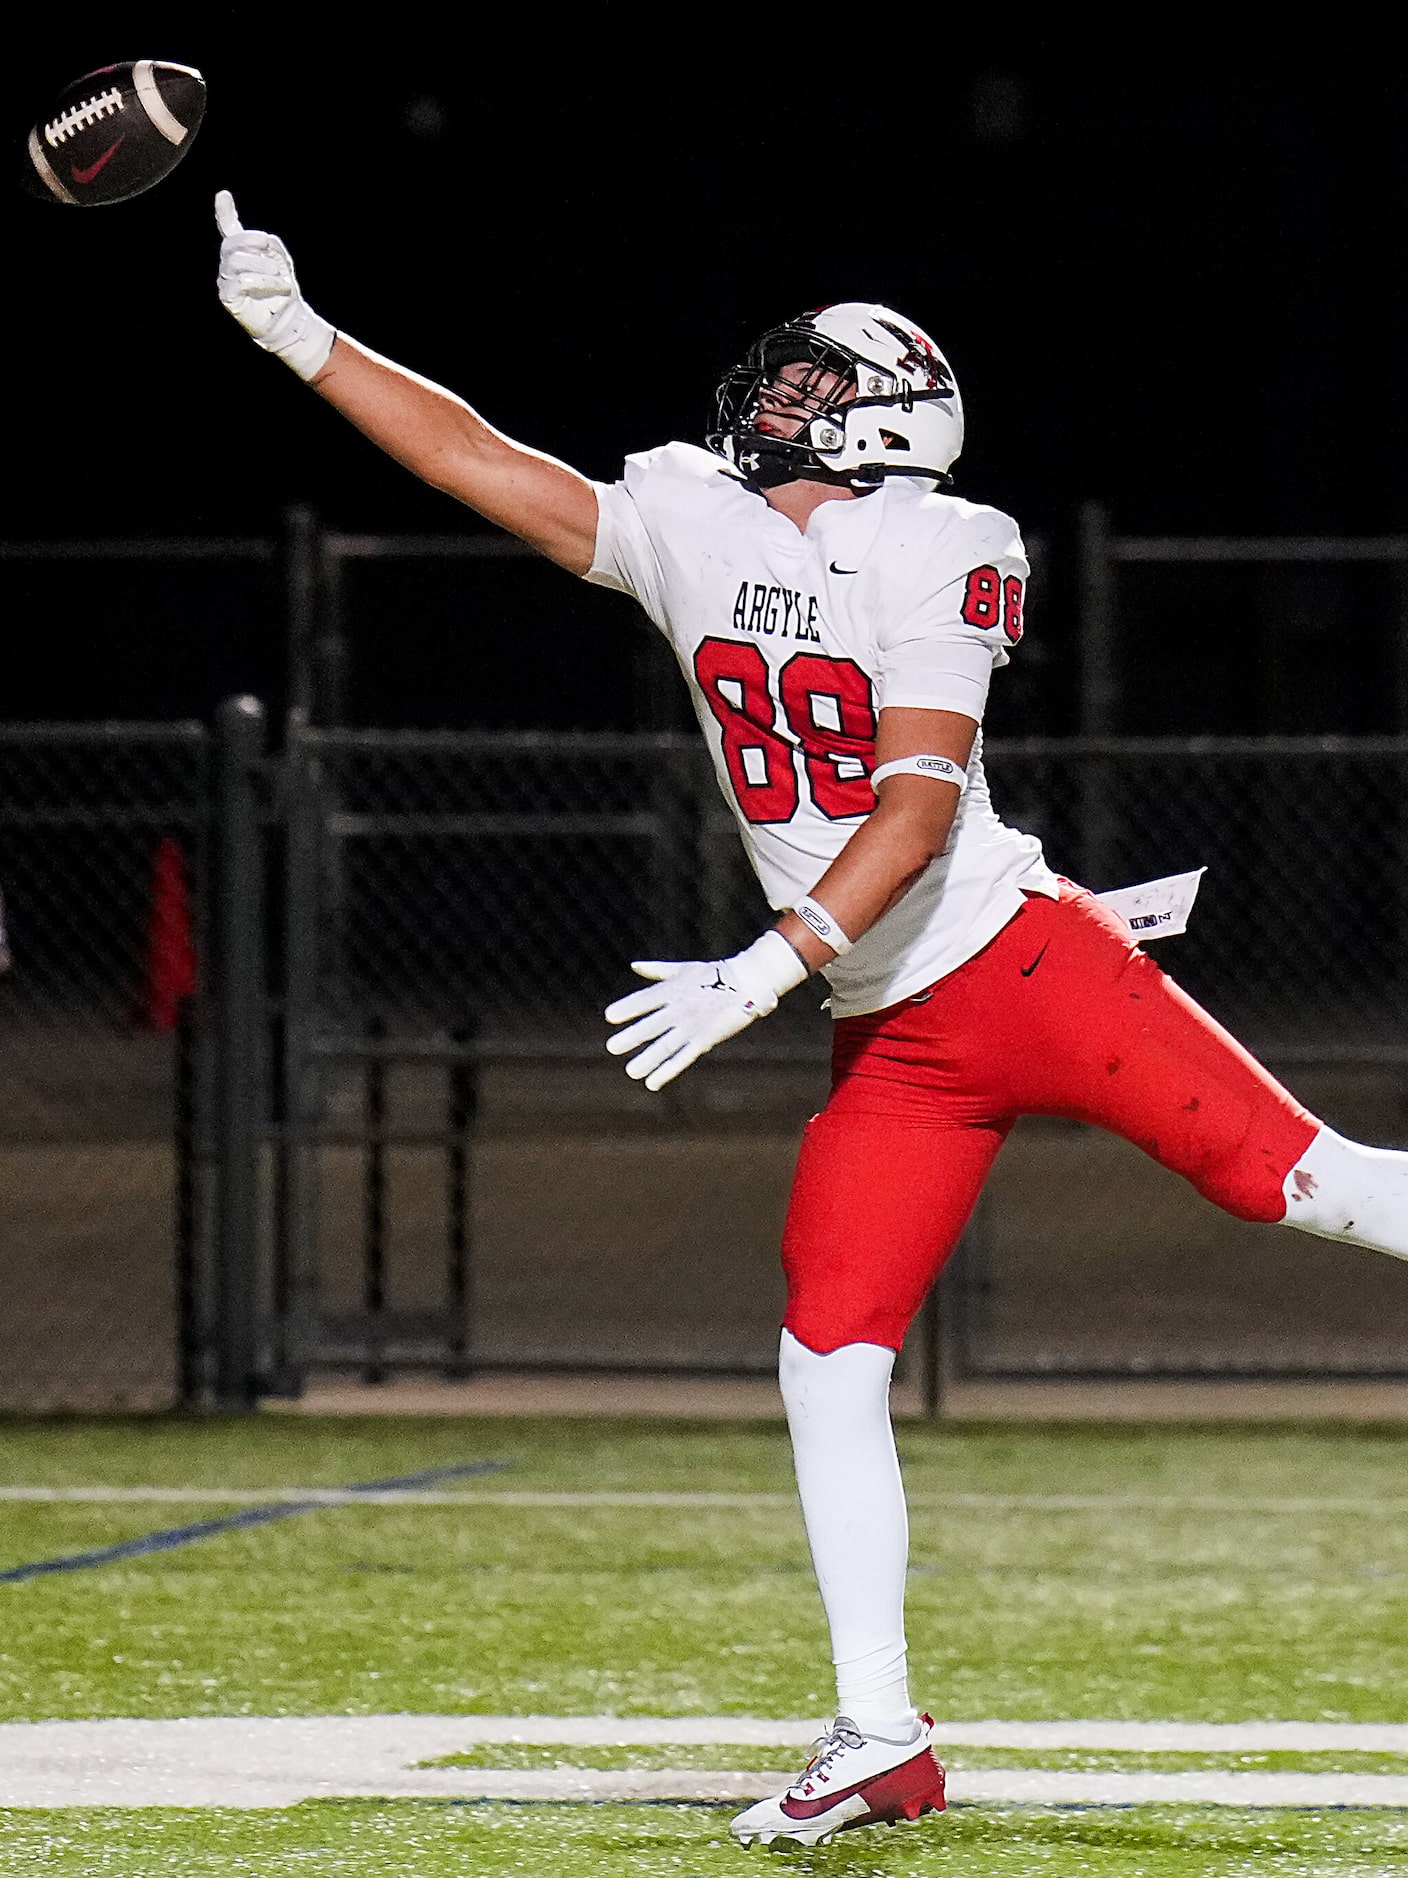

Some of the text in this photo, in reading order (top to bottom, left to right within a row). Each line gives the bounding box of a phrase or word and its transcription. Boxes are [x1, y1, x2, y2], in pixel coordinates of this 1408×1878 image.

[733, 581, 821, 643] ARGYLE
[960, 563, 1023, 645] 88
[693, 635, 877, 824] 88
